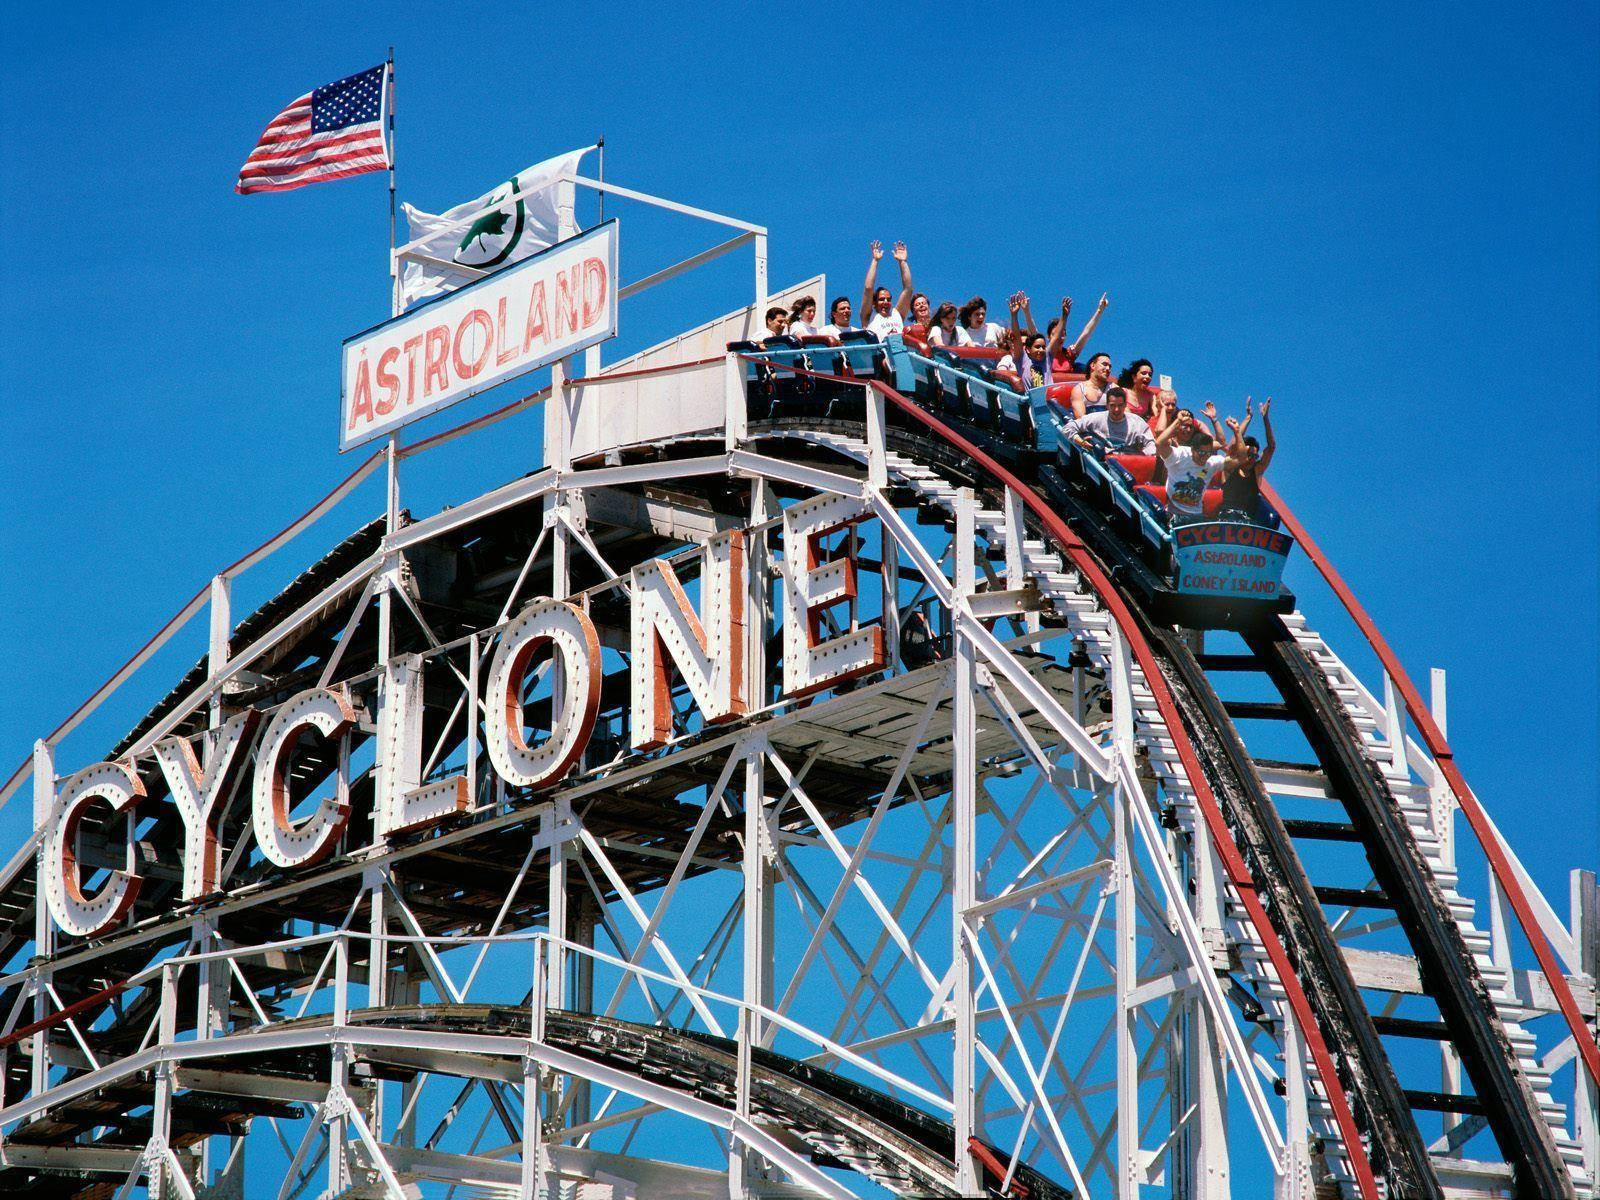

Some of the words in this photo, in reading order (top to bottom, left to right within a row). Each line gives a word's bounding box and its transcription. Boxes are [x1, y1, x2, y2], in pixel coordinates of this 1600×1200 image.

[348, 256, 607, 431] ASTROLAND
[1177, 525, 1285, 553] CYCLONE
[1194, 549, 1266, 568] ASTROLAND
[1183, 573, 1228, 590] CONEY
[1230, 578, 1276, 594] ISLAND
[44, 490, 888, 939] CYCLONE
